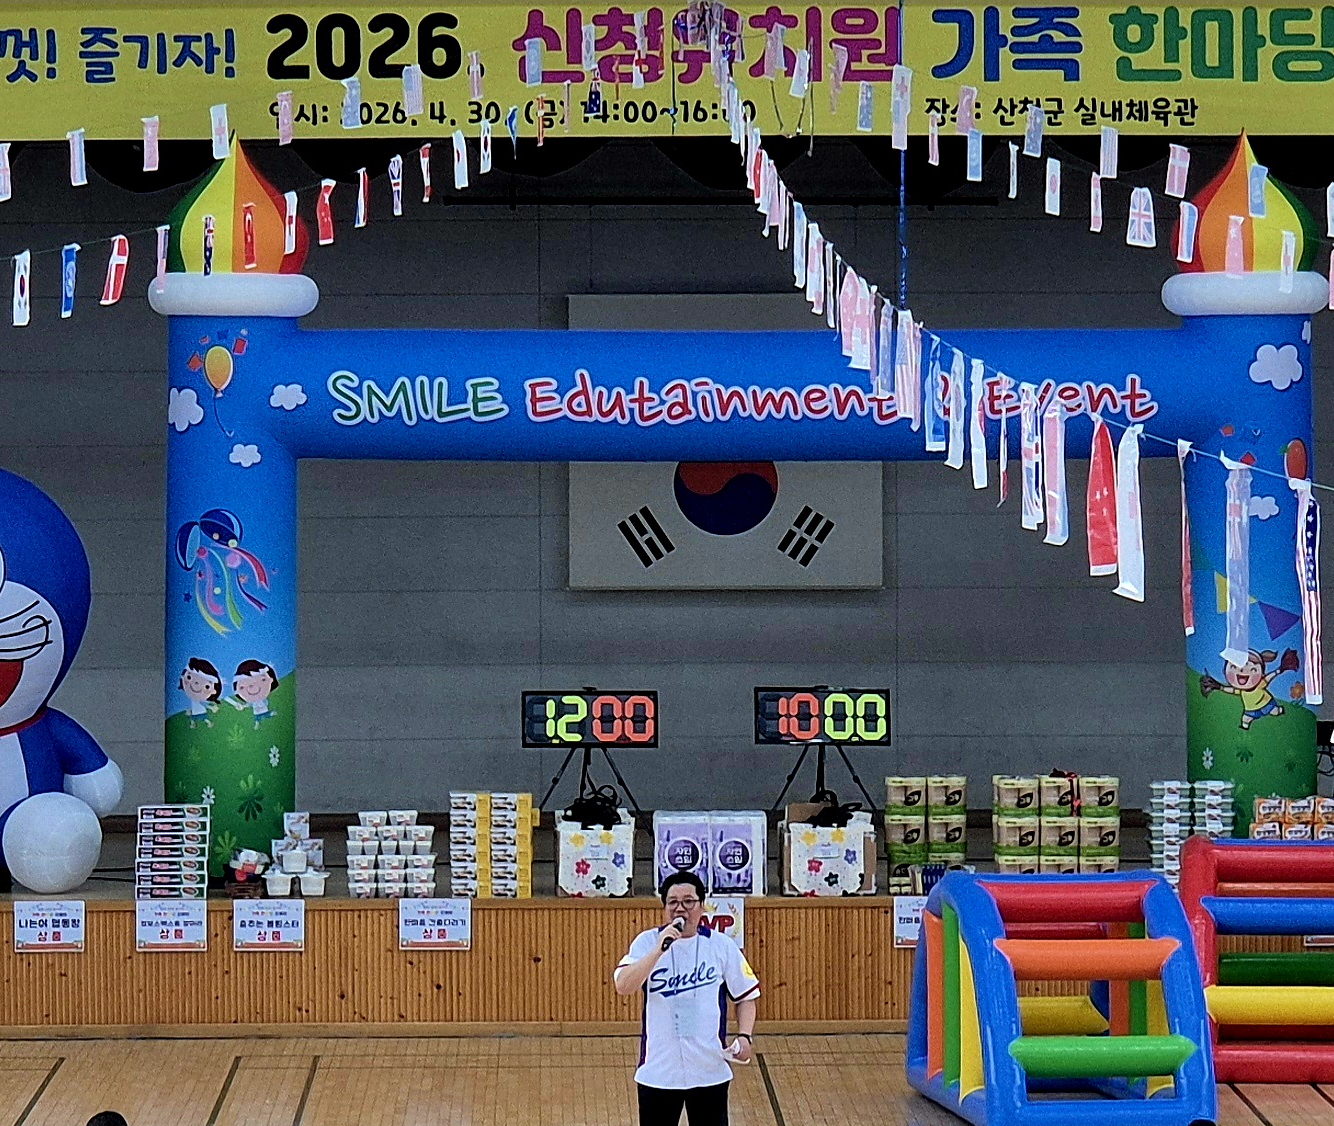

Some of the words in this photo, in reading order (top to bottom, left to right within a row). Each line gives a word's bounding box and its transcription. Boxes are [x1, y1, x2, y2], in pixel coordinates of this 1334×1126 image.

[79, 27, 236, 84] 즐기자!
[931, 5, 1083, 82] 가족
[429, 101, 456, 126] 4.
[1074, 96, 1198, 127] 실내체육관
[330, 372, 507, 423] SMILE
[528, 371, 899, 423] Edutainment
